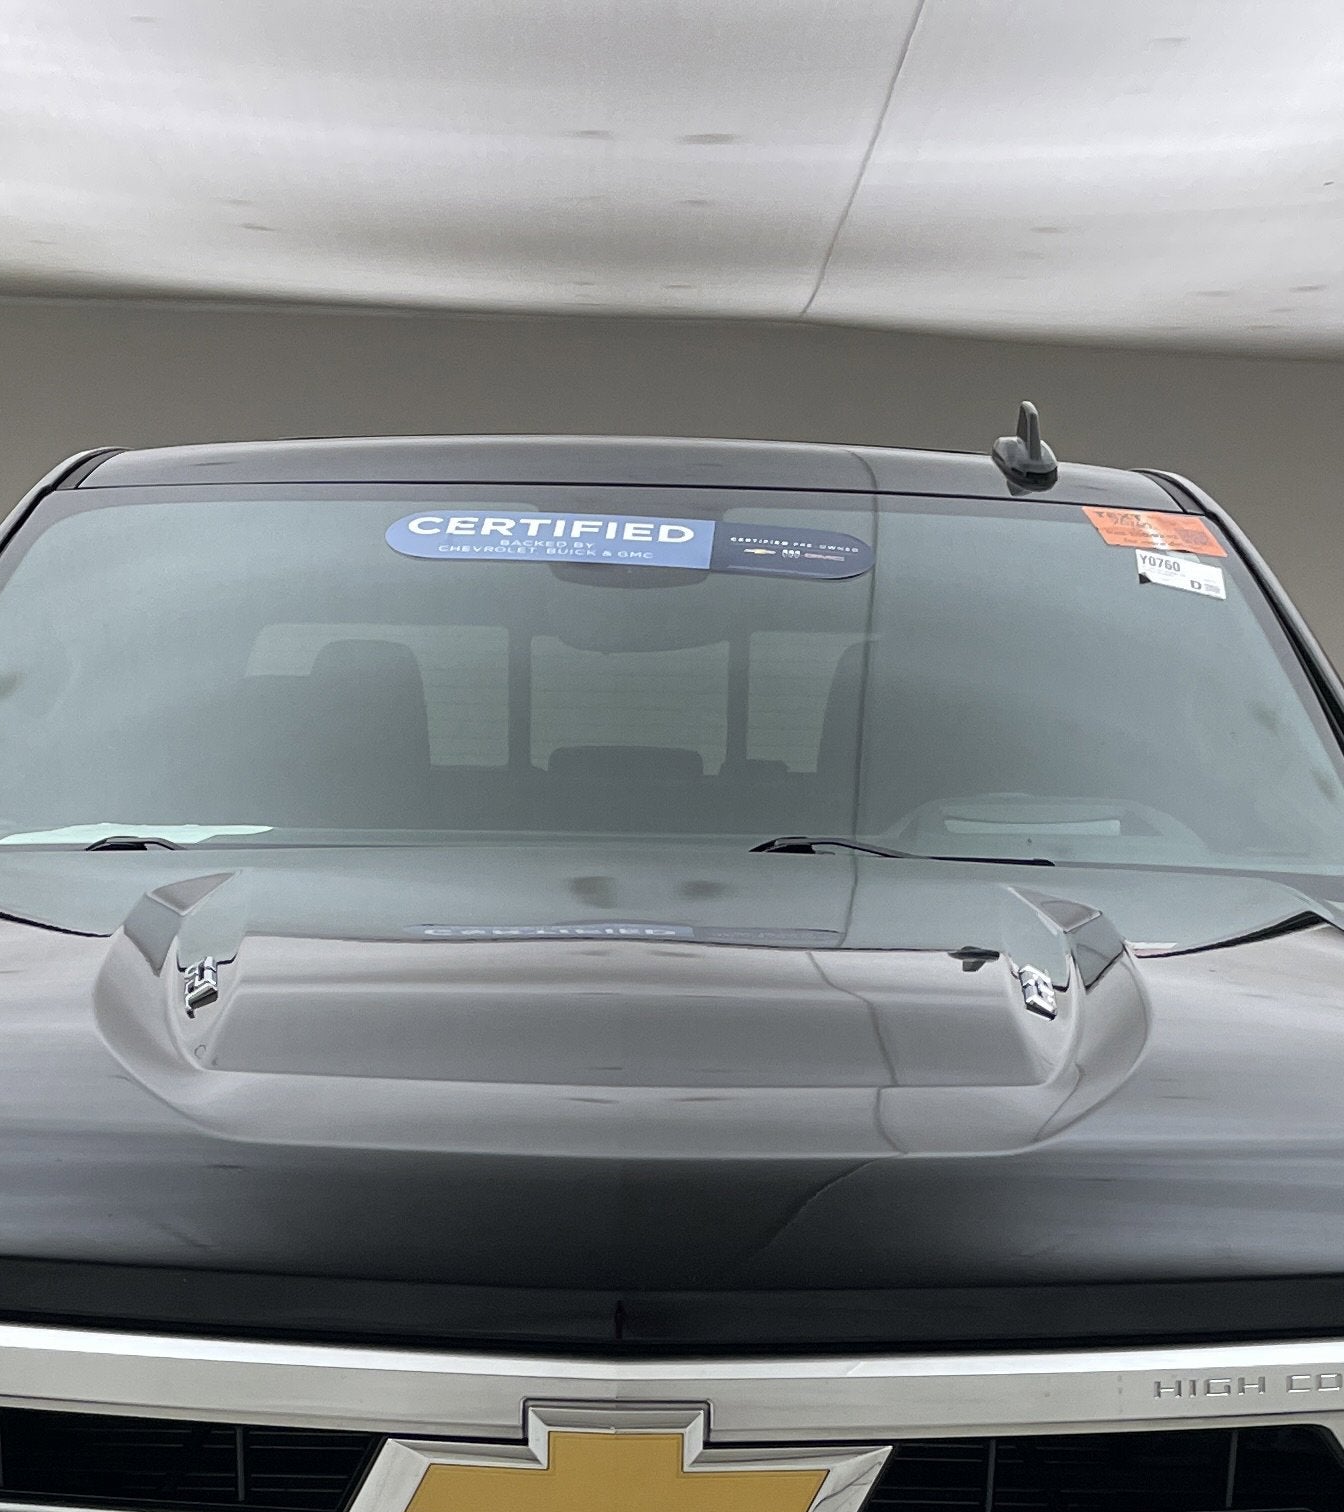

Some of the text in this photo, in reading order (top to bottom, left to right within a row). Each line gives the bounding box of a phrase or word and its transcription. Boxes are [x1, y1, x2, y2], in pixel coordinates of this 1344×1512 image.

[408, 516, 695, 543] CERTIFIED
[500, 539, 596, 549] BACKED BY
[546, 548, 597, 556] BUICK
[617, 551, 655, 559] GMC
[1139, 553, 1181, 572] Y0760
[1154, 1376, 1266, 1399] HIGH
